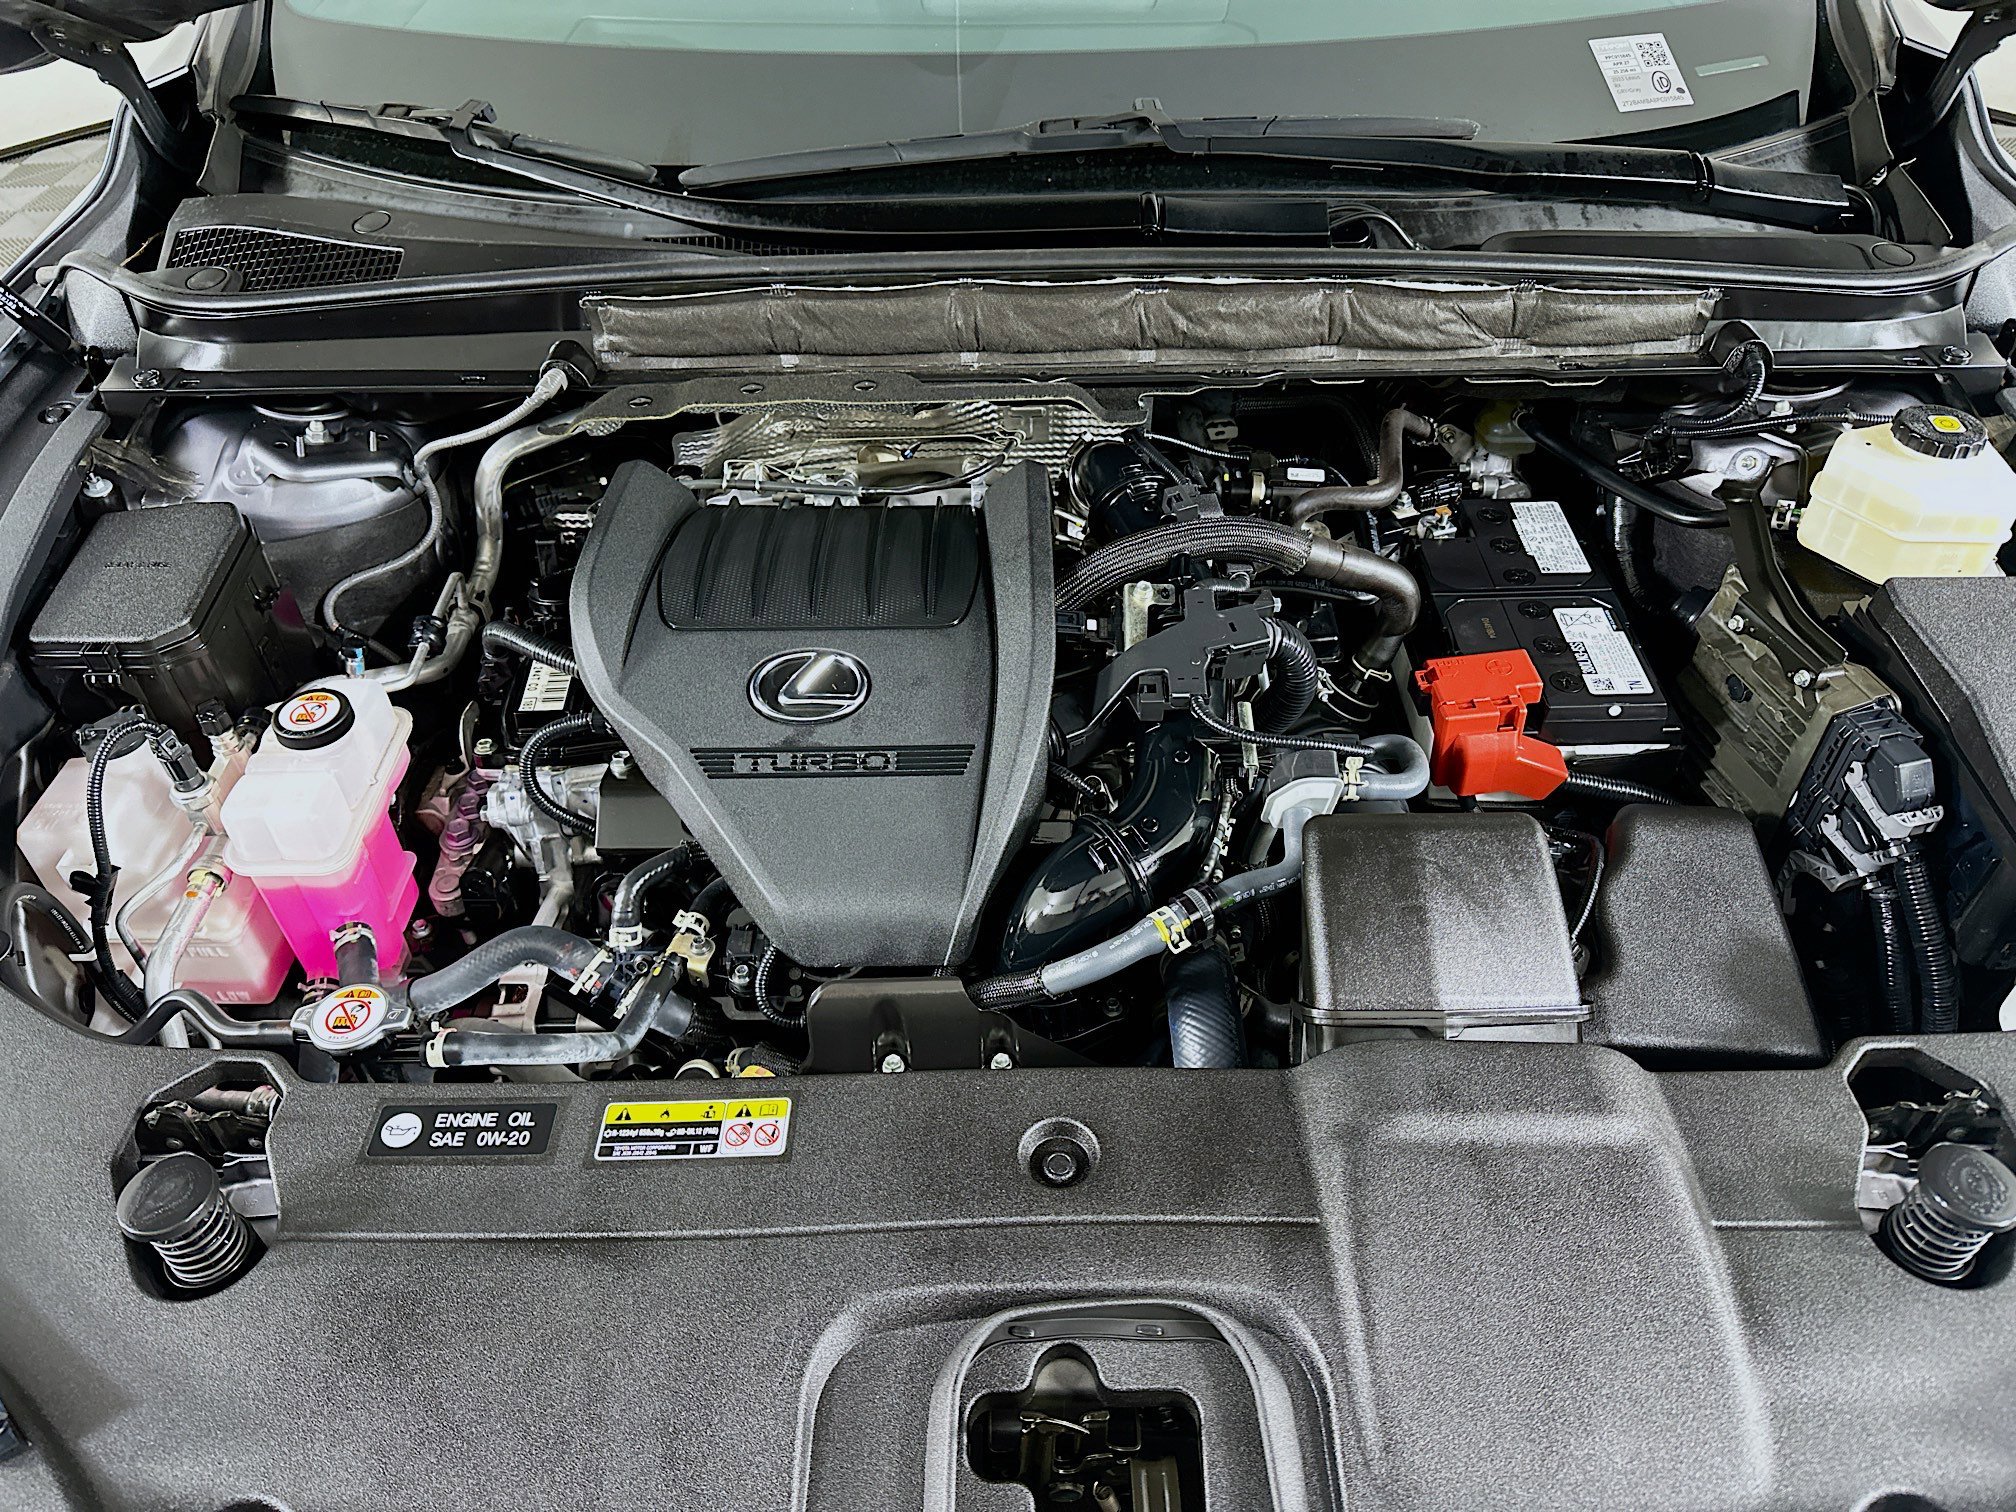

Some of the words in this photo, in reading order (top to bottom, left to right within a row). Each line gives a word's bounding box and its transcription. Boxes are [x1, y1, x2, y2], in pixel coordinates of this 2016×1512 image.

[733, 751, 898, 774] TURBO
[434, 1112, 499, 1128] ENGINE
[508, 1111, 535, 1127] OIL
[428, 1131, 467, 1147] SAE
[476, 1130, 531, 1146] 0W-20
